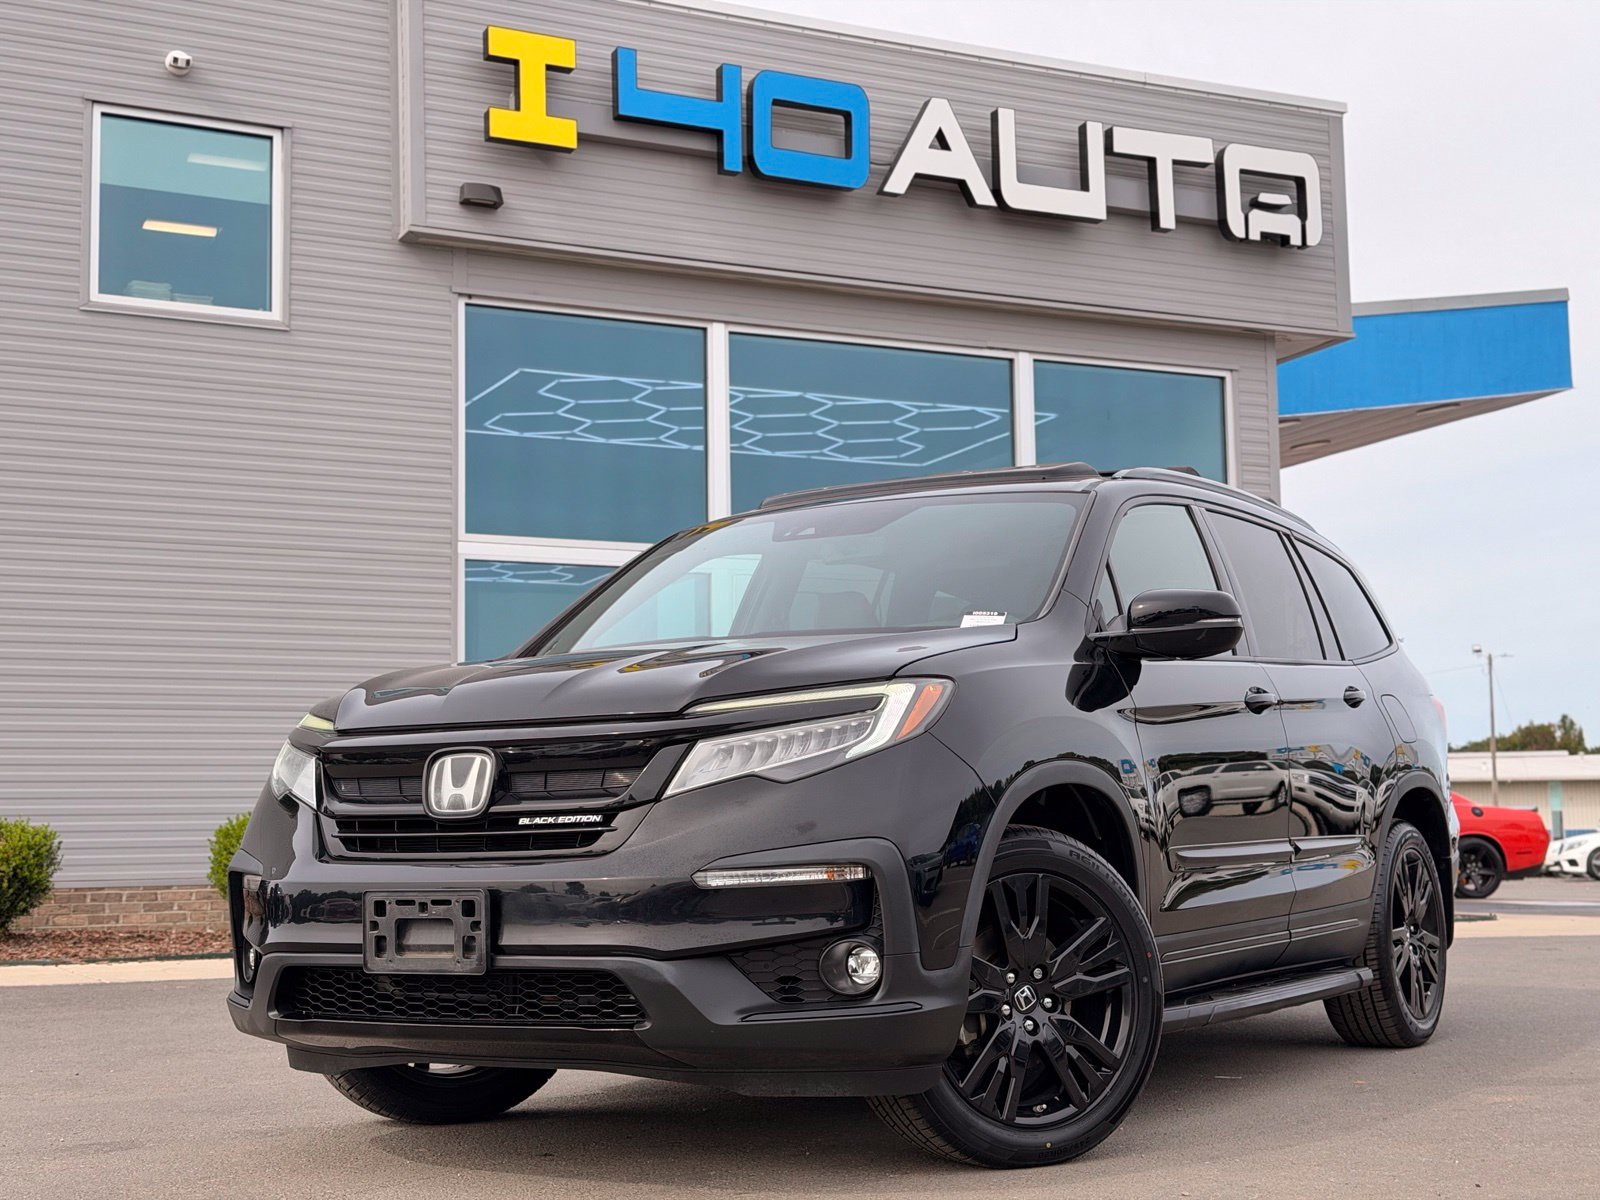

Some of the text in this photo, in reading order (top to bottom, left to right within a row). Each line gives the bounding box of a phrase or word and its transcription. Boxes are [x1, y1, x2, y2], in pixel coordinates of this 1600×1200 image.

[484, 25, 1323, 249] I 40 AUTO
[518, 815, 604, 825] BLACK EDITION
